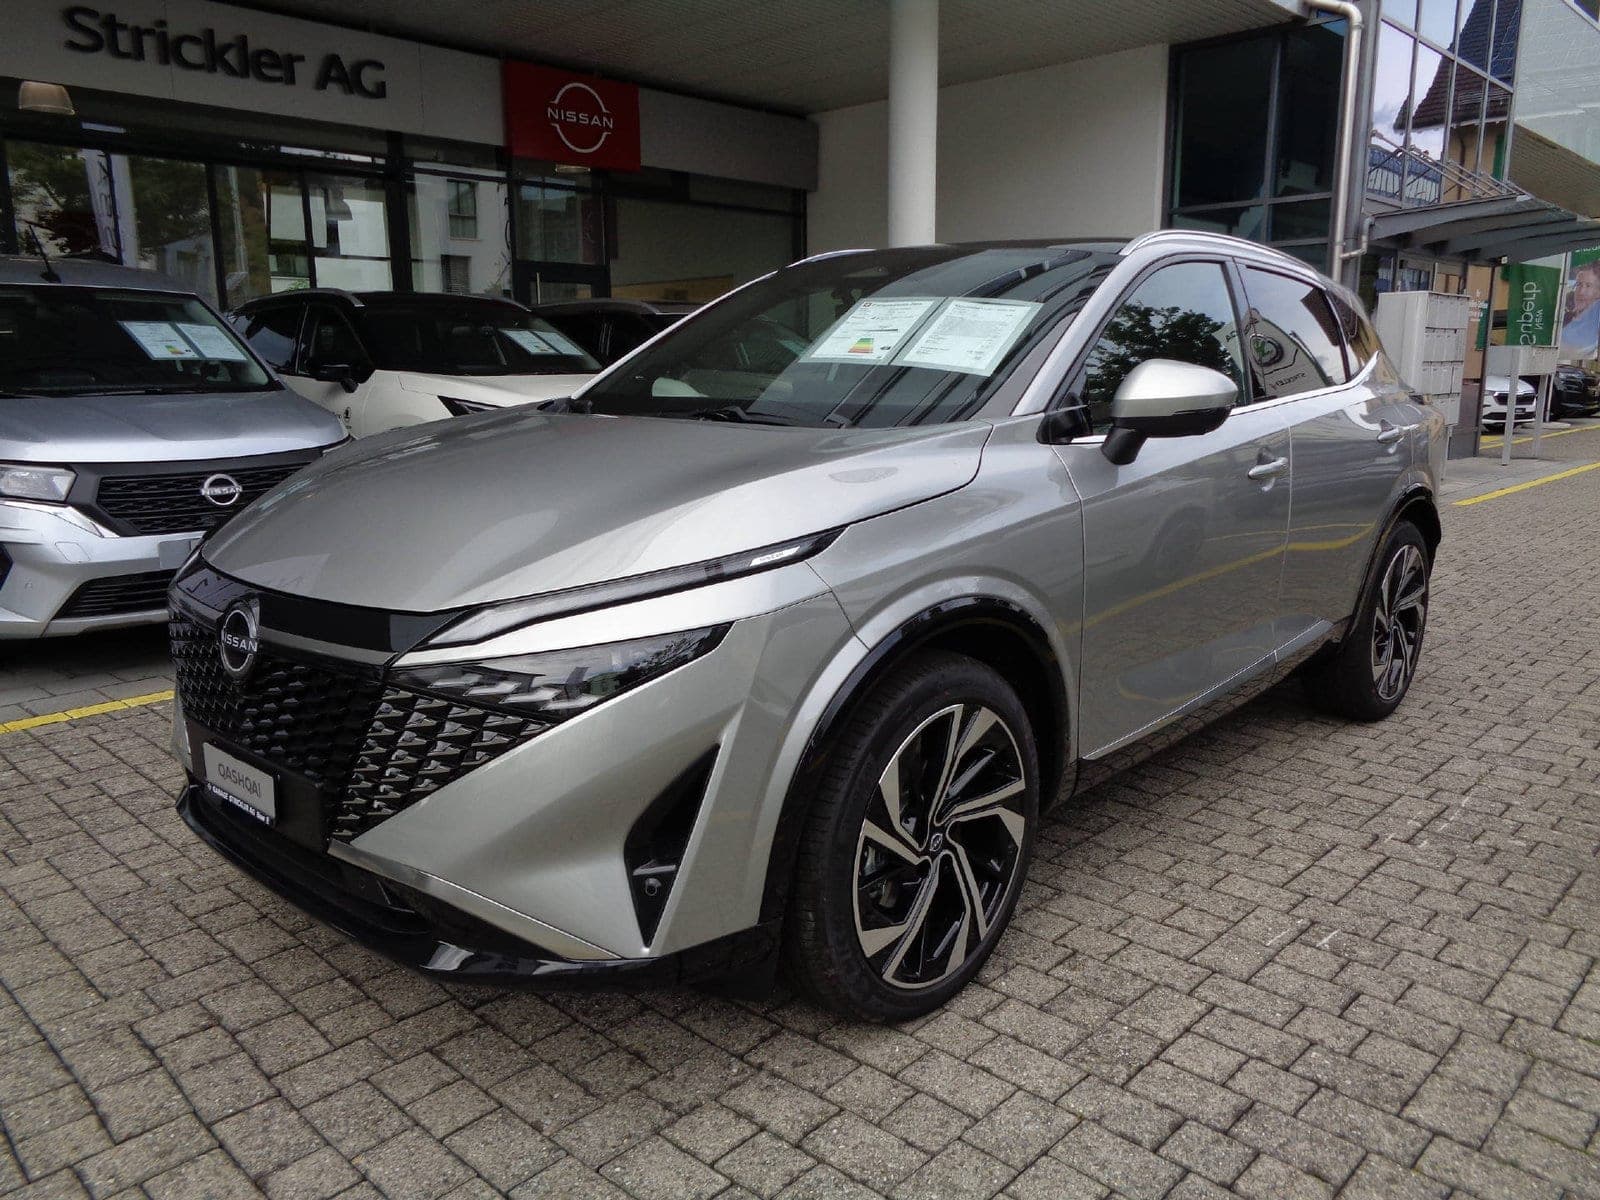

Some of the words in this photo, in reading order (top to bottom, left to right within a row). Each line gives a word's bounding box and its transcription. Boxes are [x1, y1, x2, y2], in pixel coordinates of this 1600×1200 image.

[63, 6, 304, 85] Strickler
[314, 53, 387, 99] AG
[547, 107, 613, 129] NISSAN
[218, 763, 261, 798] QASHQAI
